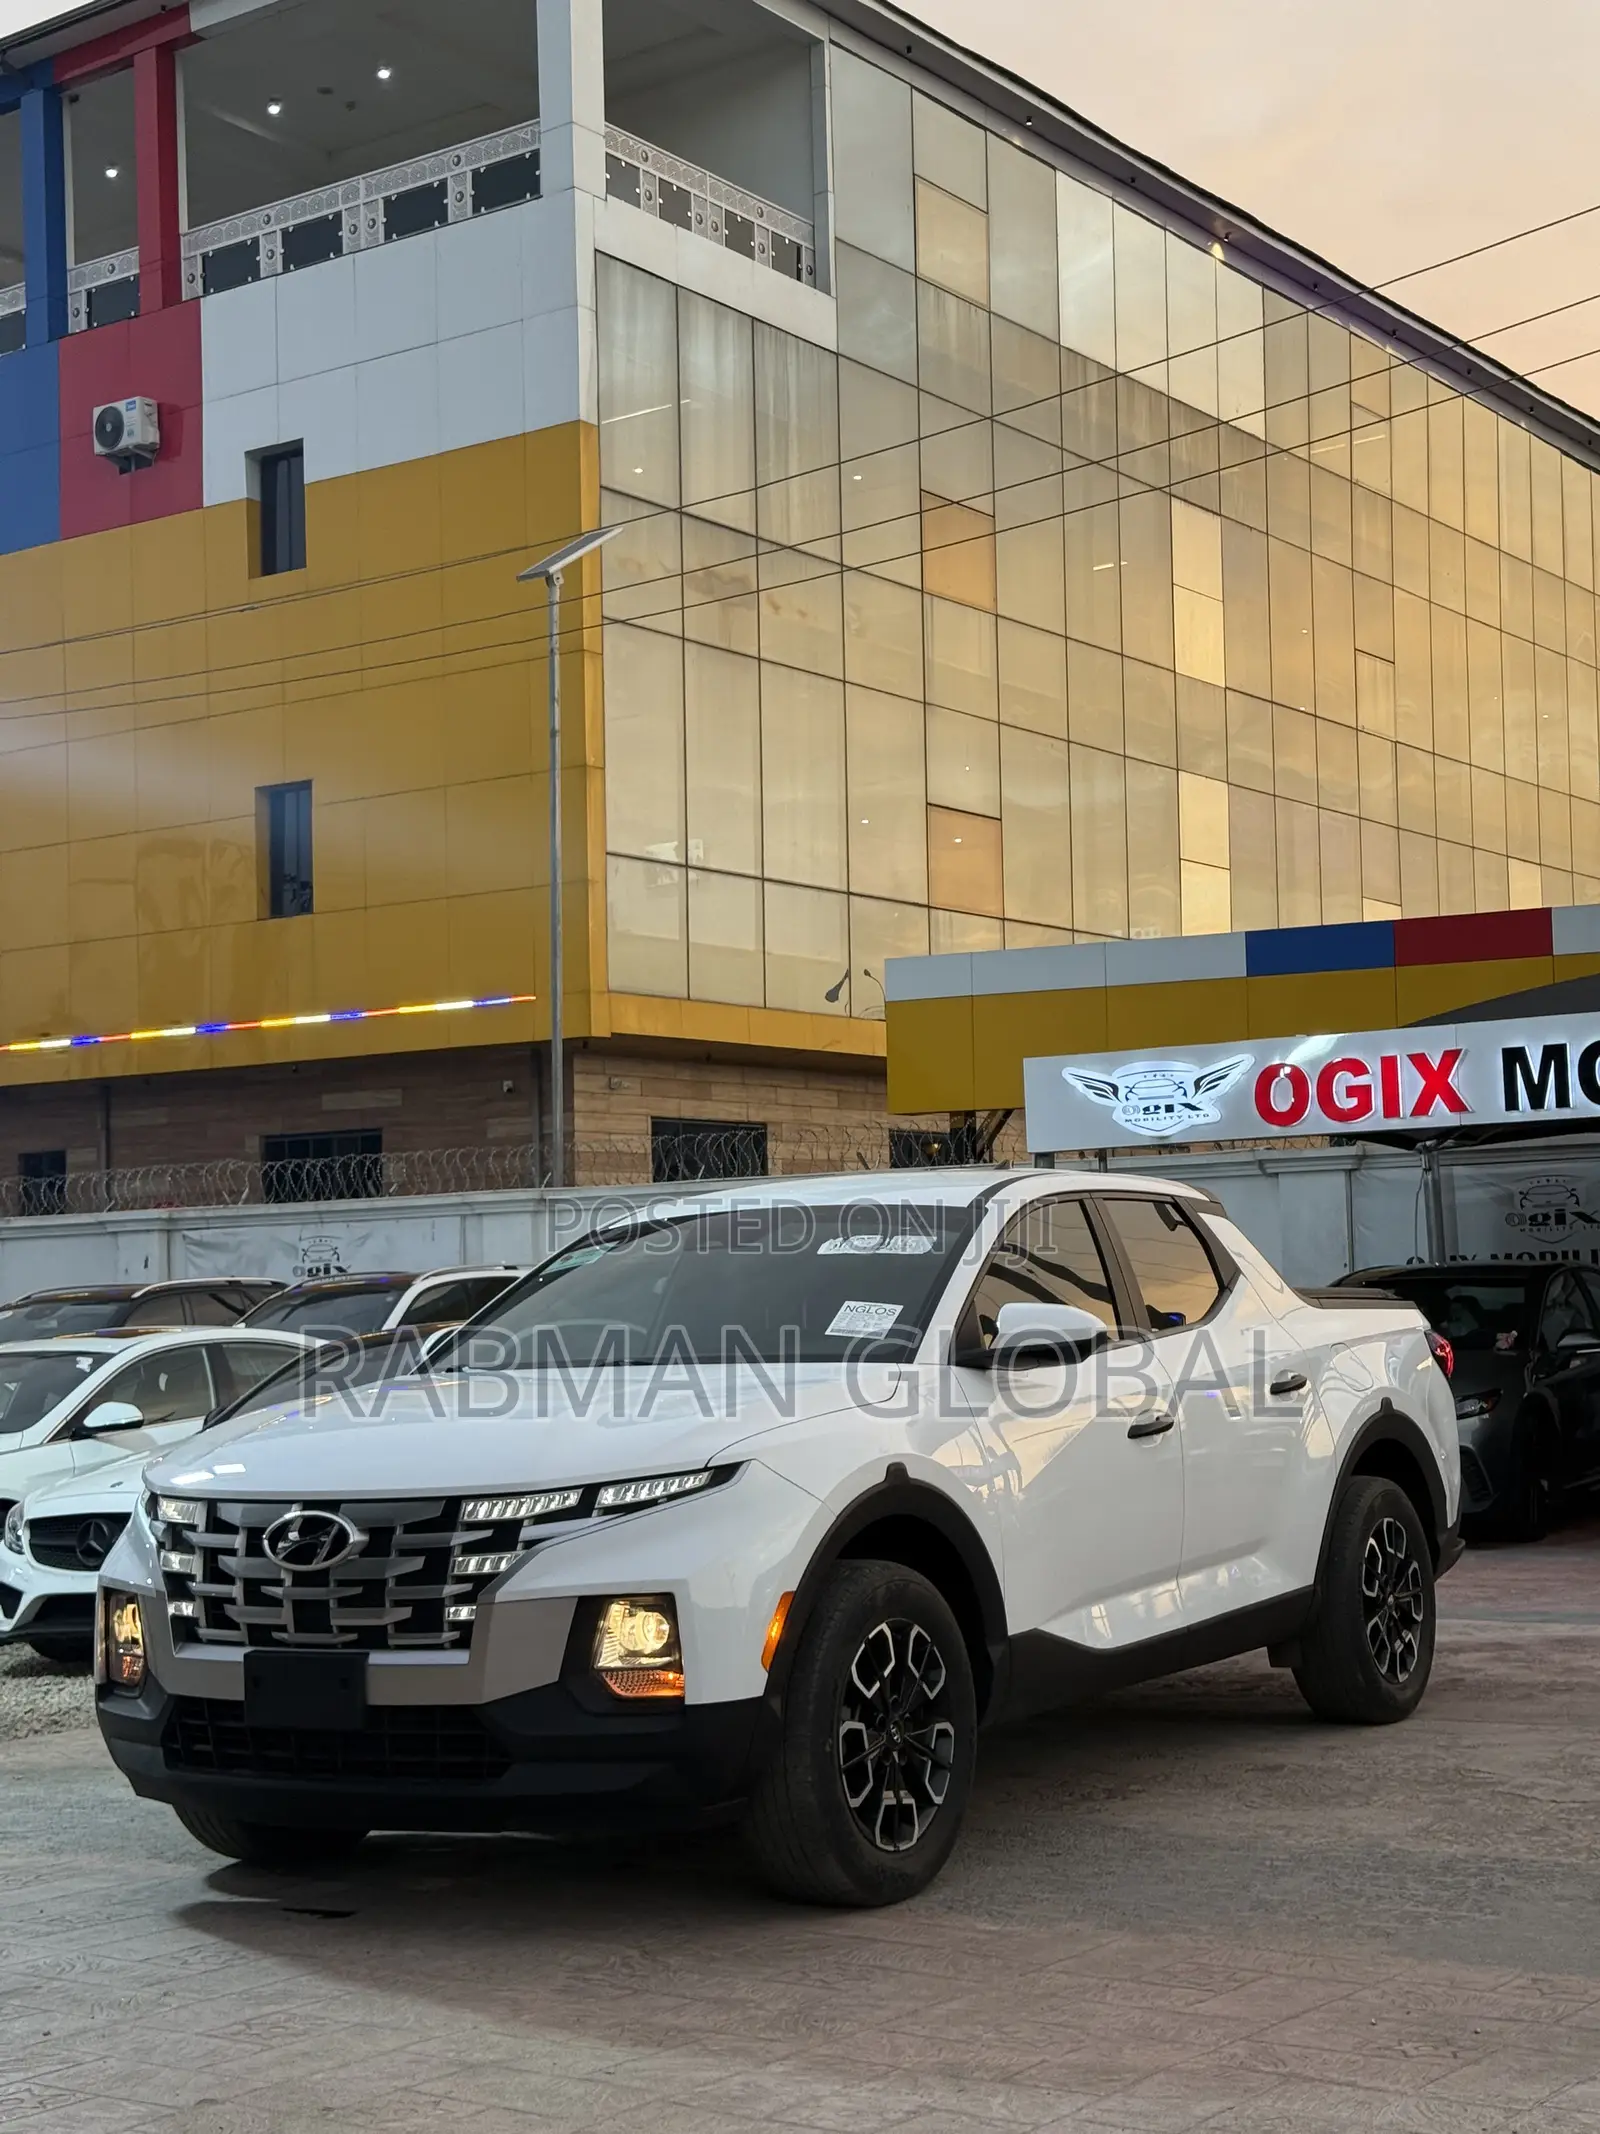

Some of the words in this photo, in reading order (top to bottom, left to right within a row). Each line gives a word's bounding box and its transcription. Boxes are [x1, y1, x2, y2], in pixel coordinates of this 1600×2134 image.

[1255, 1048, 1474, 1127] OGIX
[1124, 1114, 1183, 1123] MOBILITY
[844, 1304, 897, 1317] NGLOS
